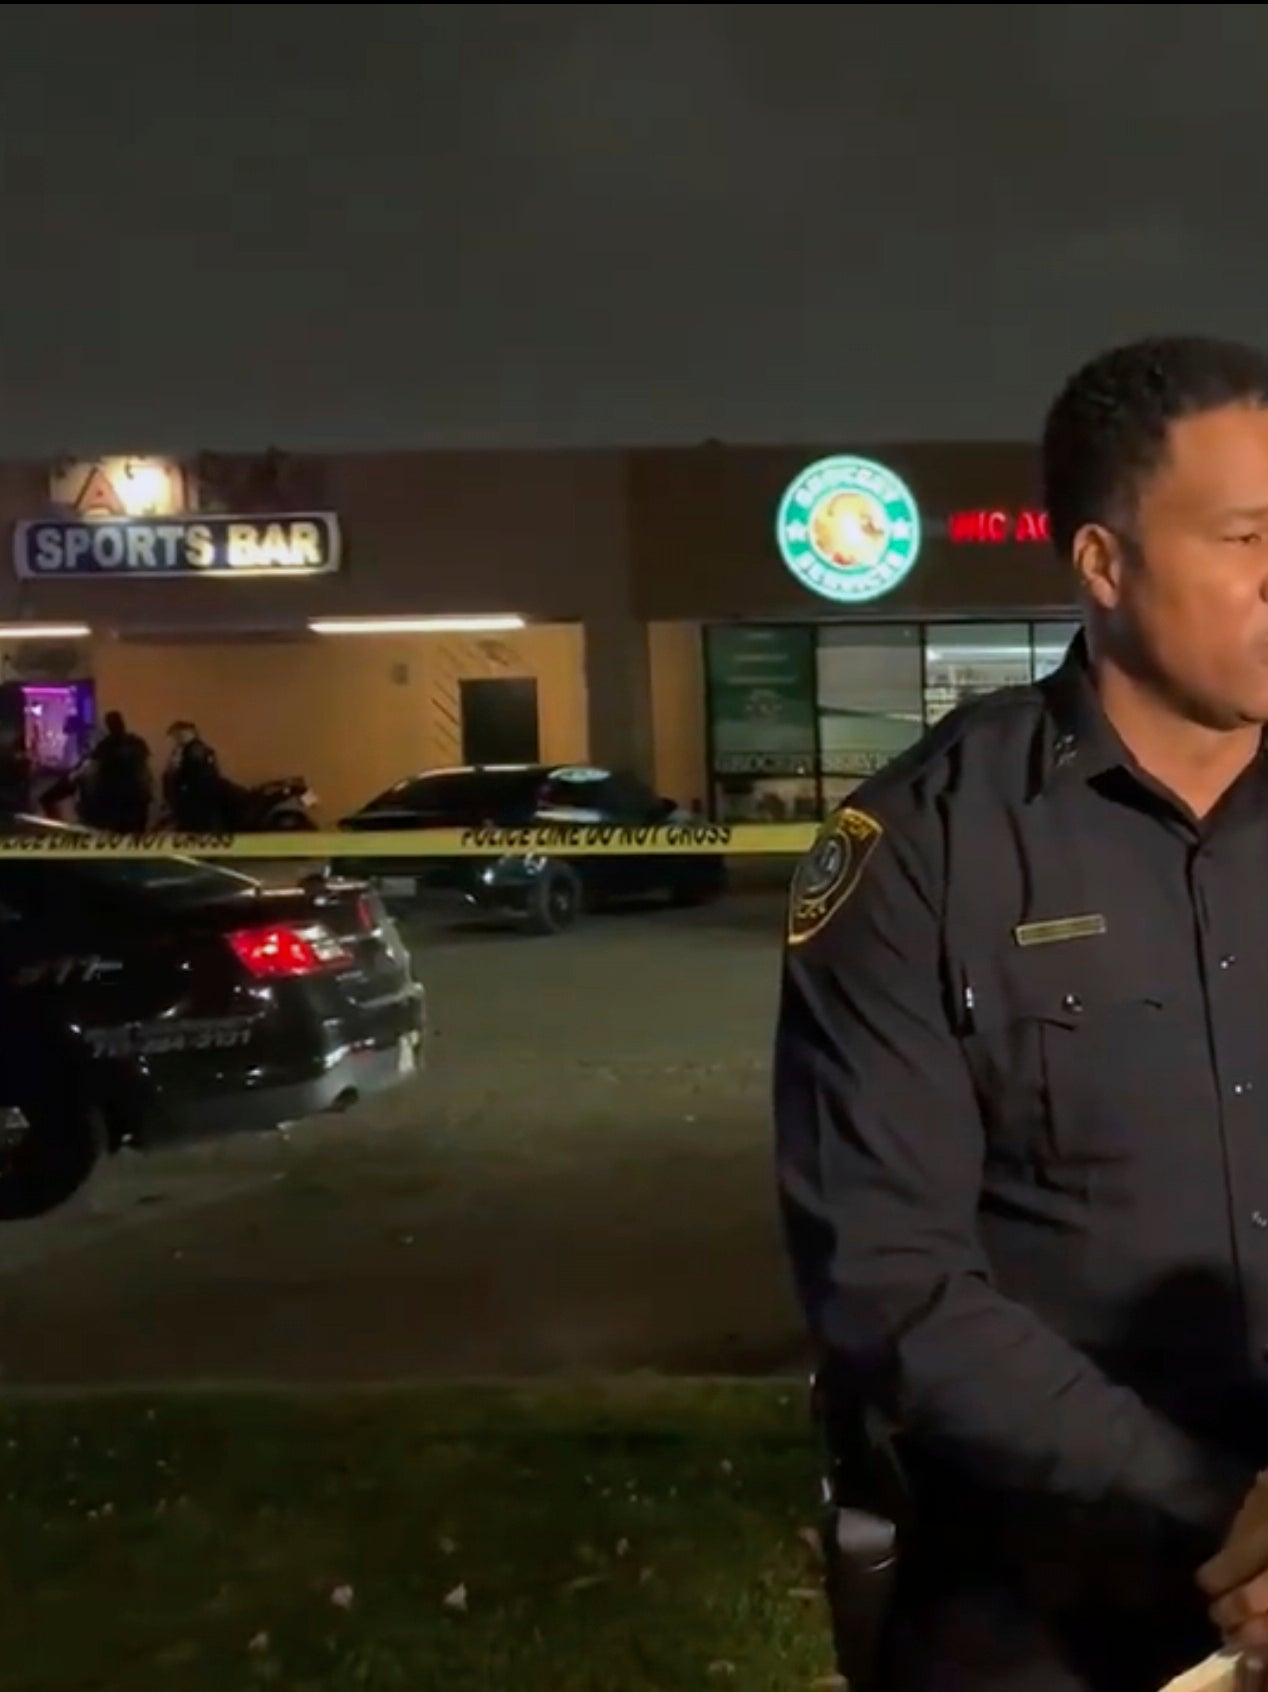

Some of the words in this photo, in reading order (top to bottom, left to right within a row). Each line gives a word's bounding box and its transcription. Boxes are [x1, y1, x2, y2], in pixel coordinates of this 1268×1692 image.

[36, 525, 215, 570] SPORTS
[227, 521, 323, 567] BAR
[461, 824, 531, 848] POLICE
[534, 824, 580, 847] LINE
[618, 824, 662, 846] NOT
[665, 823, 733, 846] CROSS
